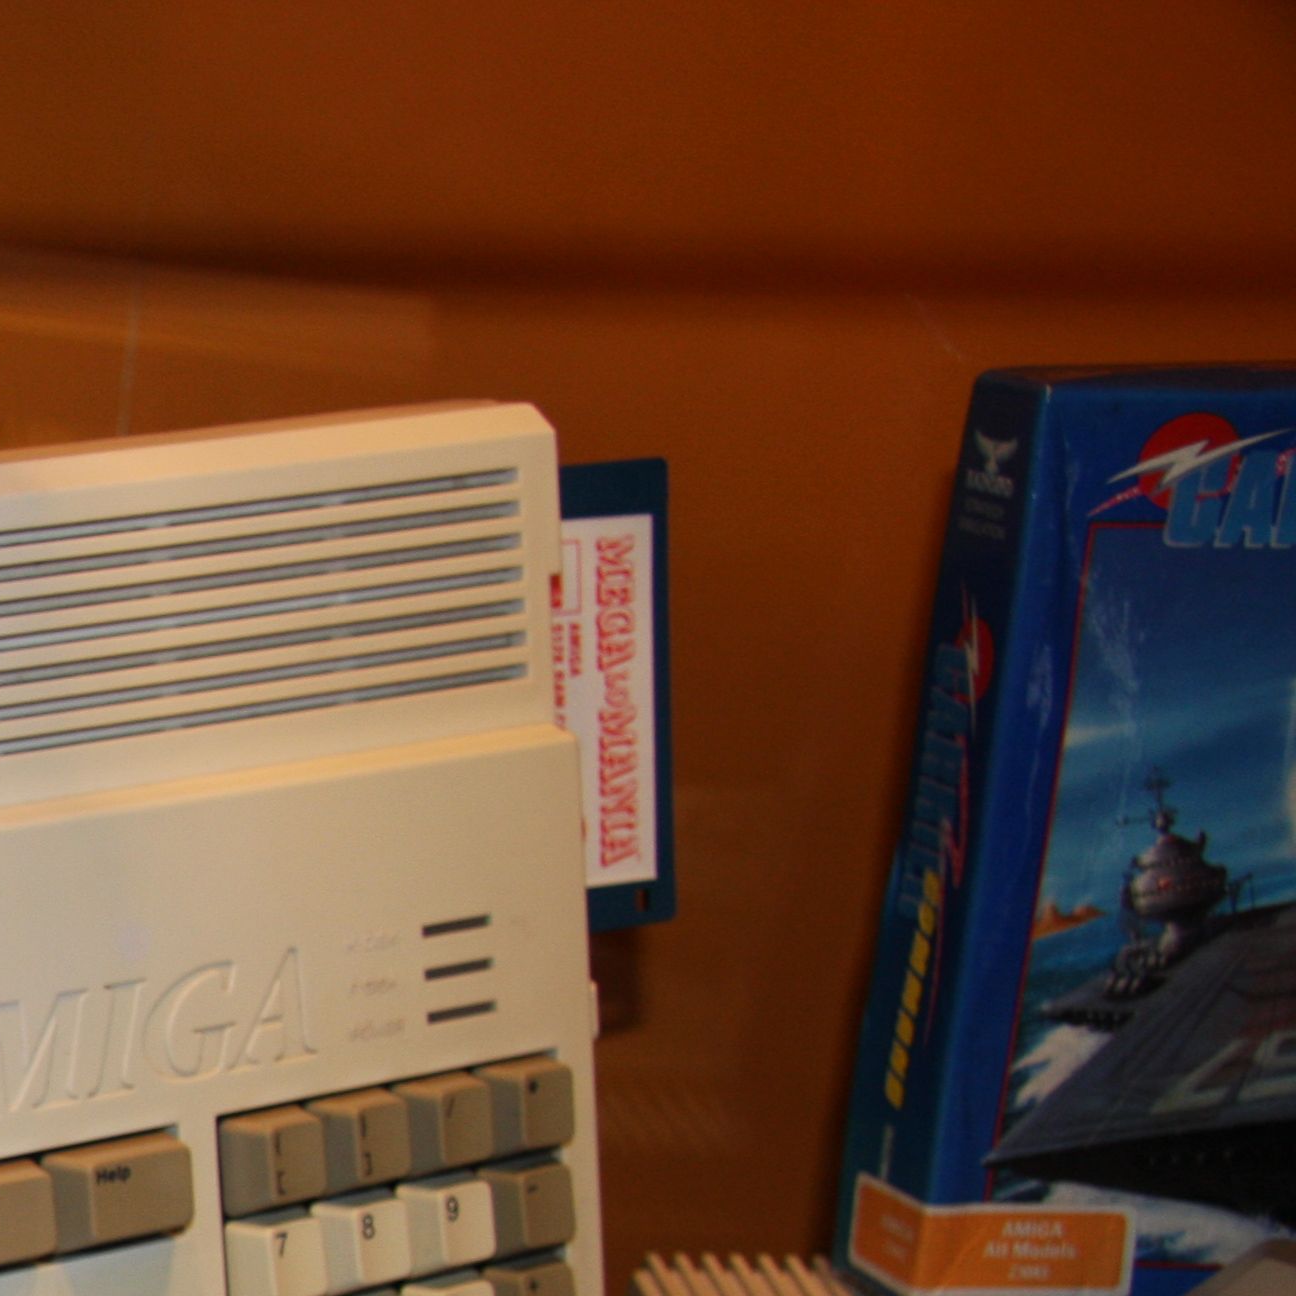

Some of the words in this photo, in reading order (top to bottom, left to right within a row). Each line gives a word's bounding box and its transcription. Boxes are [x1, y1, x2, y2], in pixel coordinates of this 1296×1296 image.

[446, 1196, 460, 1222] 9
[361, 1214, 376, 1240] 8
[274, 1232, 288, 1258] 7
